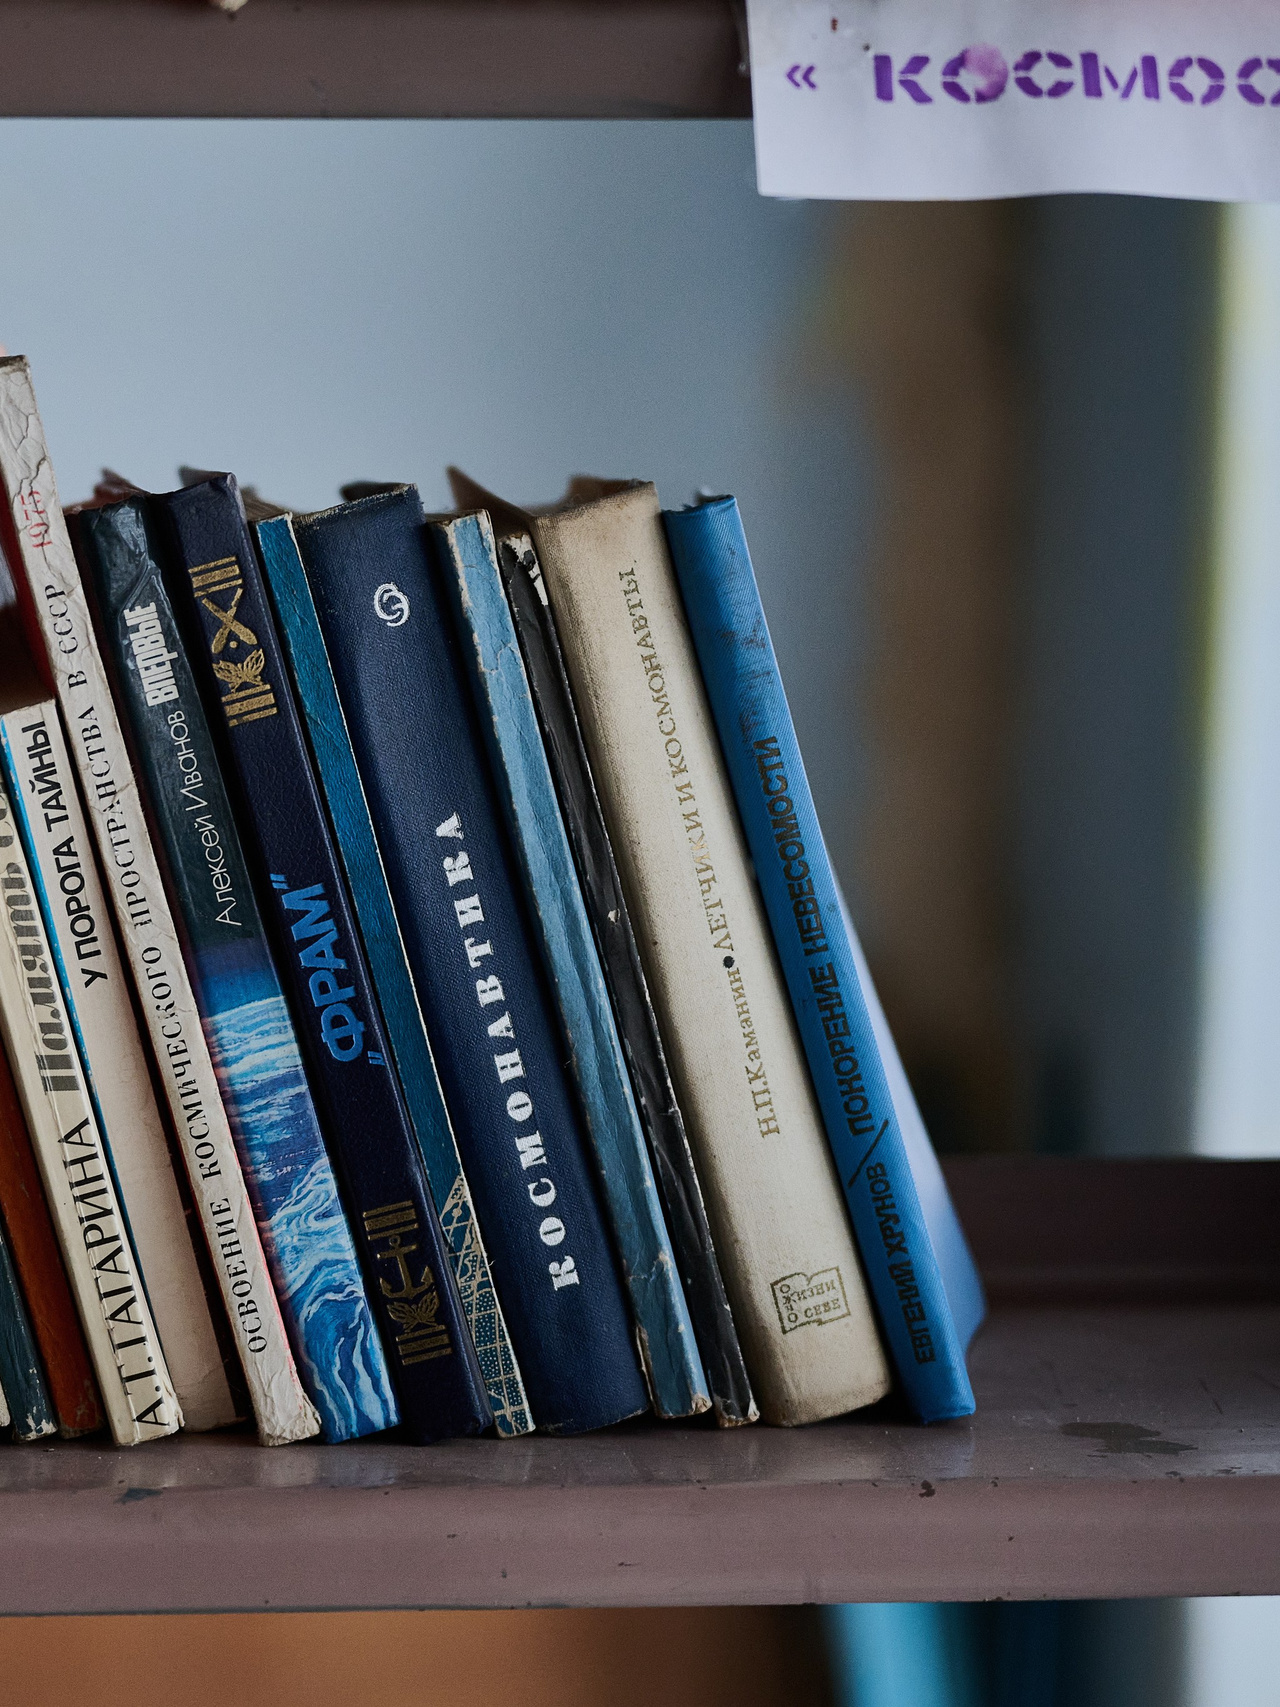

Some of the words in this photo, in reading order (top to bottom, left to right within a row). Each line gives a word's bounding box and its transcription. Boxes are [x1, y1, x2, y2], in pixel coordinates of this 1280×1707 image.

[20, 490, 53, 549] 1975
[44, 583, 82, 655] СССР
[67, 668, 88, 690] В
[17, 719, 71, 830] ТАЙНЫ
[175, 708, 213, 814] Иванов
[673, 782, 696, 807] И
[80, 705, 154, 929] ПРОСТРАНСТВА
[184, 813, 244, 928] Алексей
[752, 736, 835, 959] НЕВЕСОМОСТИ
[49, 835, 101, 962] ПОРОГА
[682, 811, 736, 953] ЛЕТЧИКИ
[4, 862, 82, 1093] Память
[81, 967, 110, 990] У
[141, 945, 224, 1183] КОСМИЧЕСКОГО
[435, 811, 583, 1293] КОСМОНАВТИКА
[809, 960, 876, 1138] ПОКОРЕНИЕ
[865, 1161, 910, 1255] ХРУНОВ
[206, 1197, 269, 1356] ОСВОЕНИЕ
[782, 1279, 837, 1305] ЖИЗНИ
[804, 1298, 841, 1319] СЕБЕ
[888, 1258, 938, 1365] ЕВГЕНИЙ
